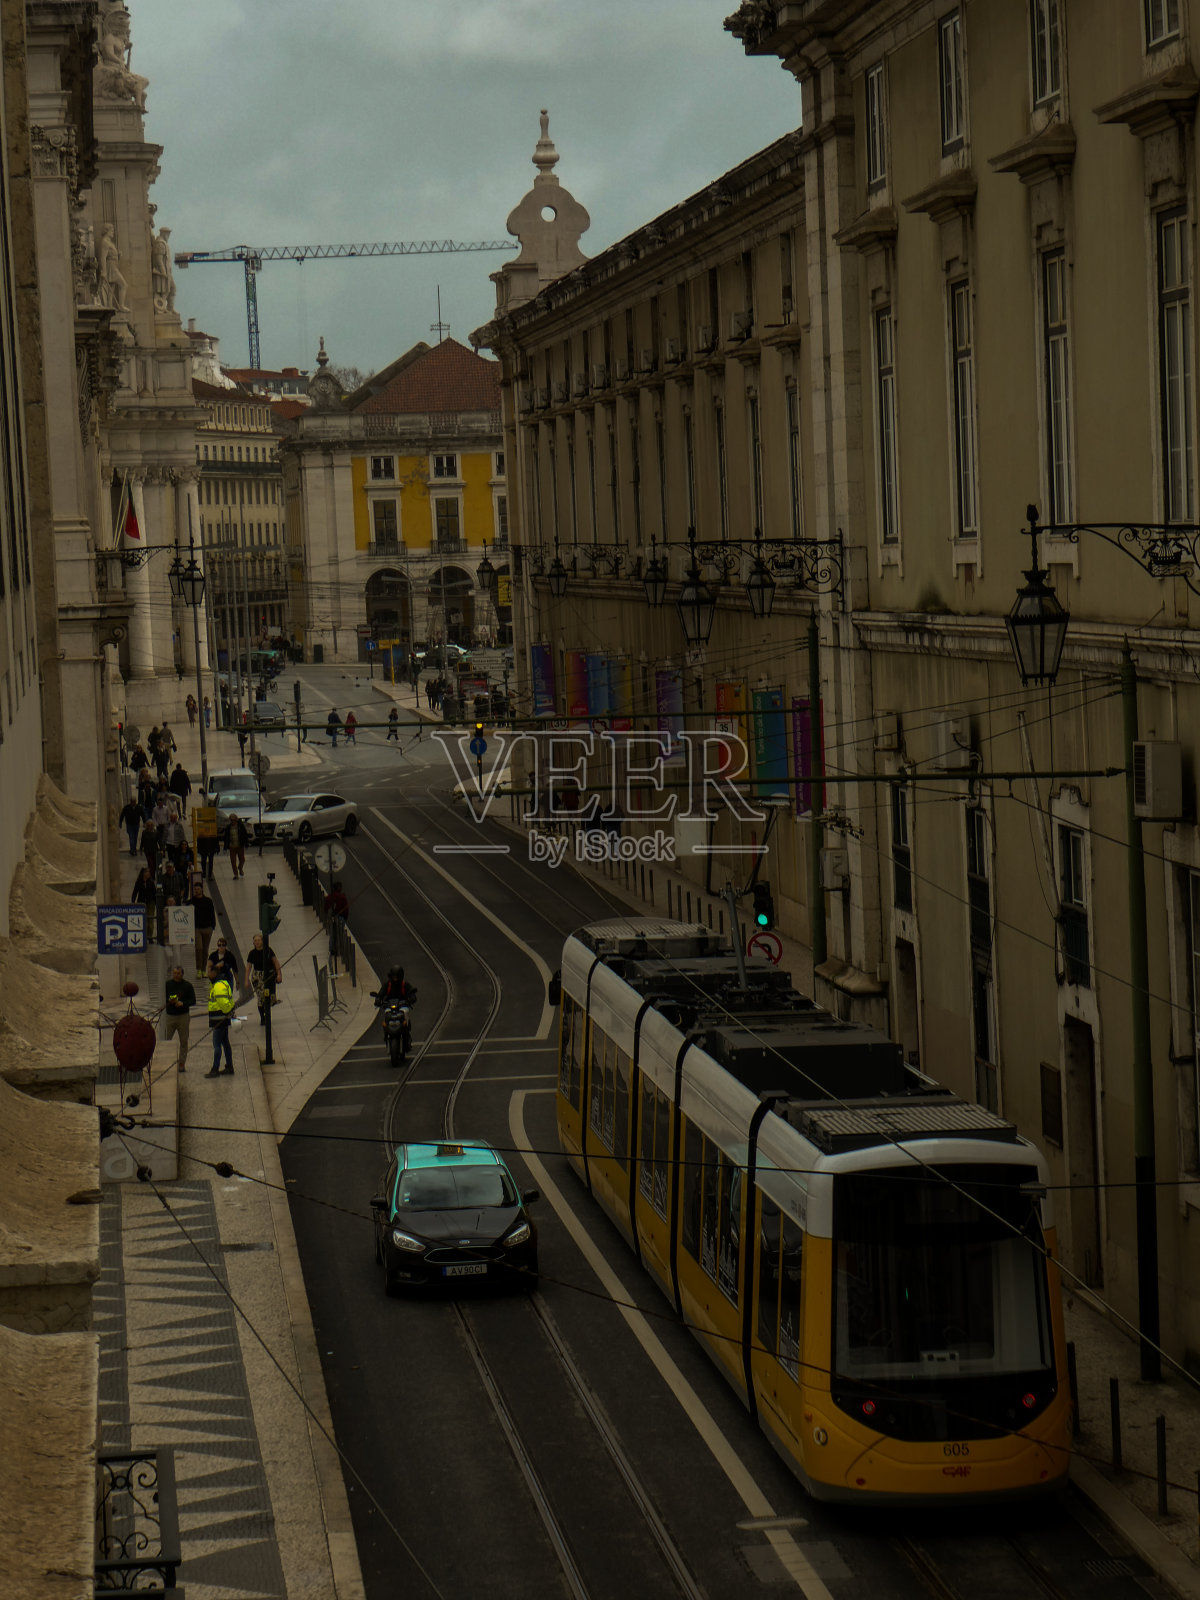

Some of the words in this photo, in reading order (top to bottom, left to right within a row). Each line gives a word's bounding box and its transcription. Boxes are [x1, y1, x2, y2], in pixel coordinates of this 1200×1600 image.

[719, 723, 729, 733] 35
[105, 924, 123, 945] P
[943, 1442, 970, 1457] 605
